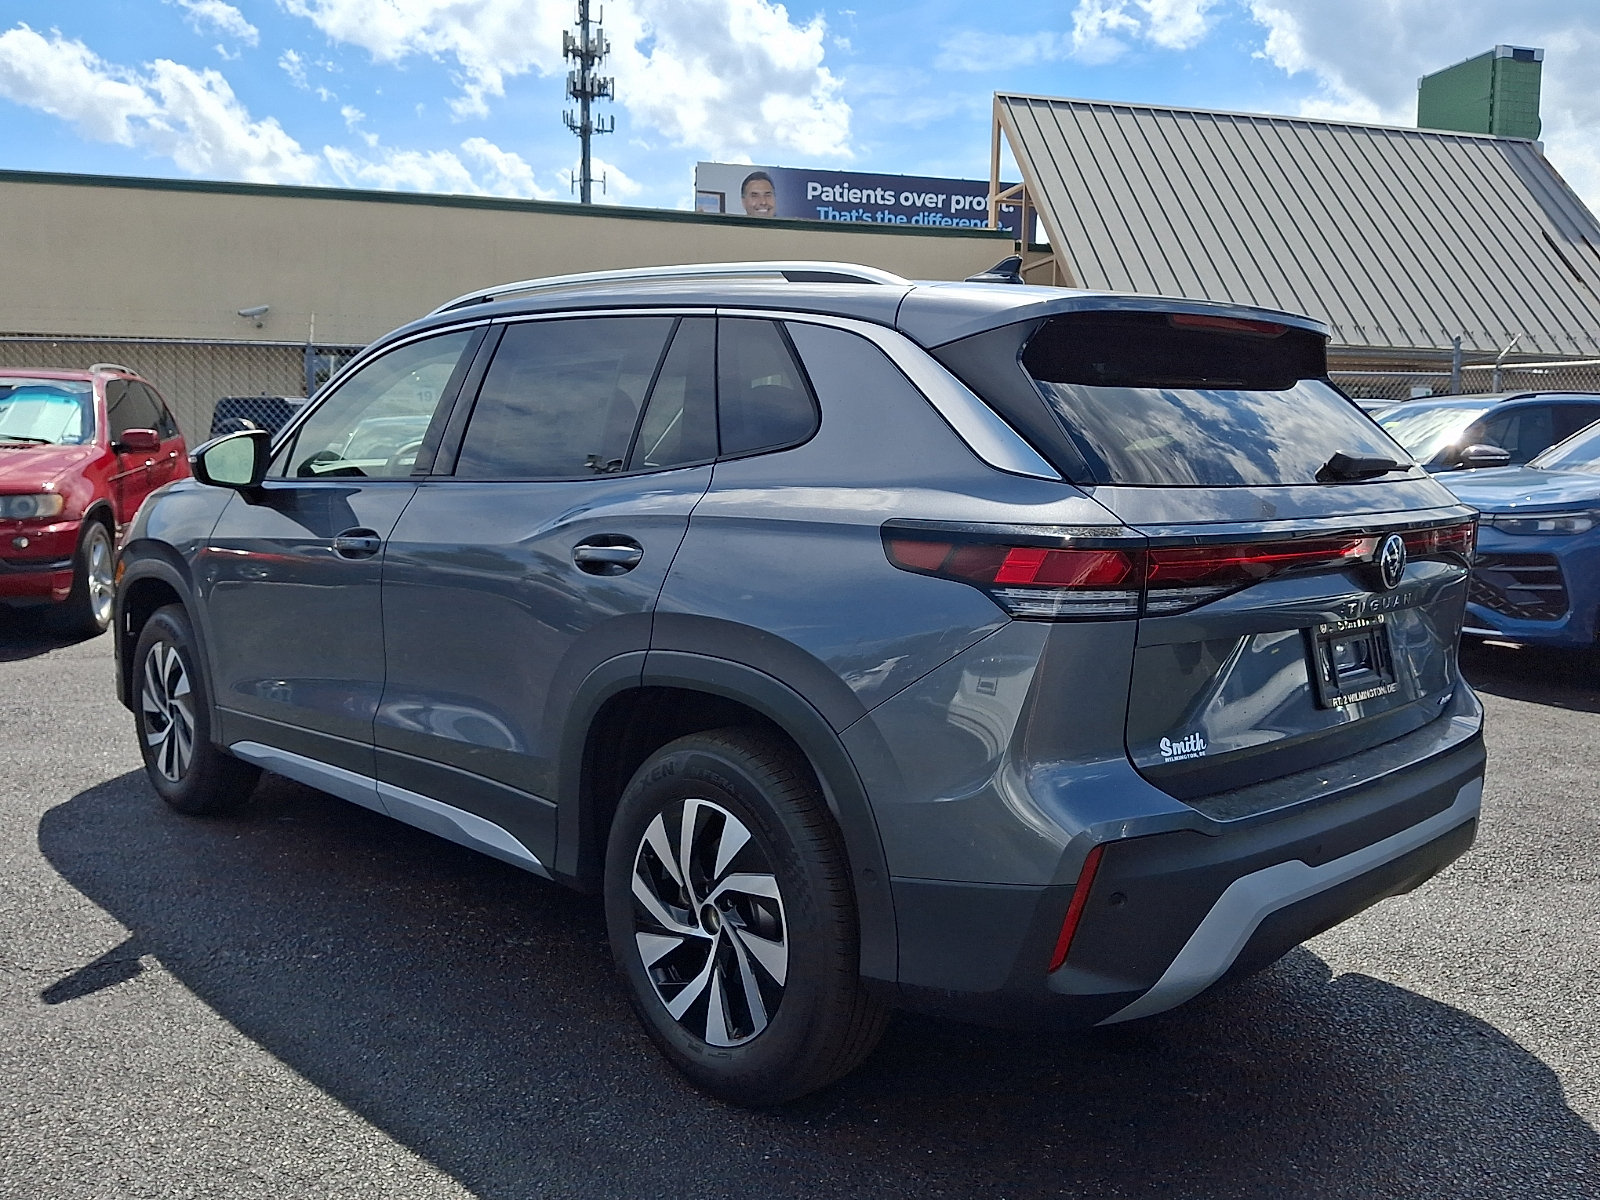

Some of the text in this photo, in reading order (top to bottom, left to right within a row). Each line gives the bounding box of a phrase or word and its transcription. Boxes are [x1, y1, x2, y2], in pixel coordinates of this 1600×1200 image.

[807, 181, 1015, 213] Patients over prot.
[816, 206, 873, 222] That's
[876, 210, 907, 225] the
[1347, 593, 1412, 615] TIGUAN
[1160, 732, 1207, 757] Smith
